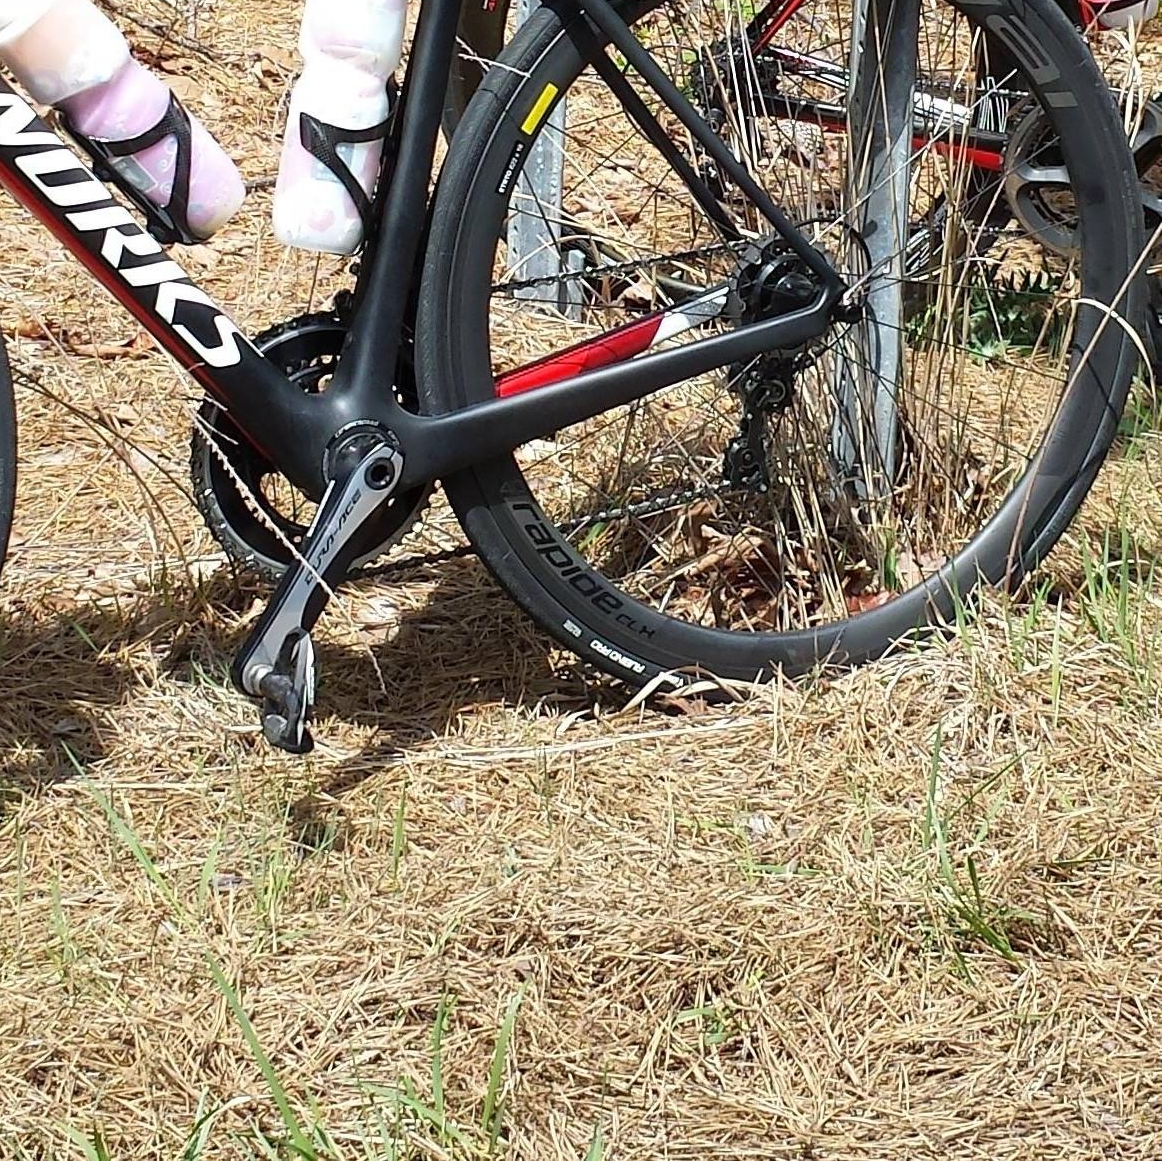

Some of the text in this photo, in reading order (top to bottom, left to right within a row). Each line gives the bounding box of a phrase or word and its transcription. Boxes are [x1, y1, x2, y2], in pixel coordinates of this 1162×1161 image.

[512, 503, 624, 615] rapide
[590, 639, 646, 675] RUBINO PRO
